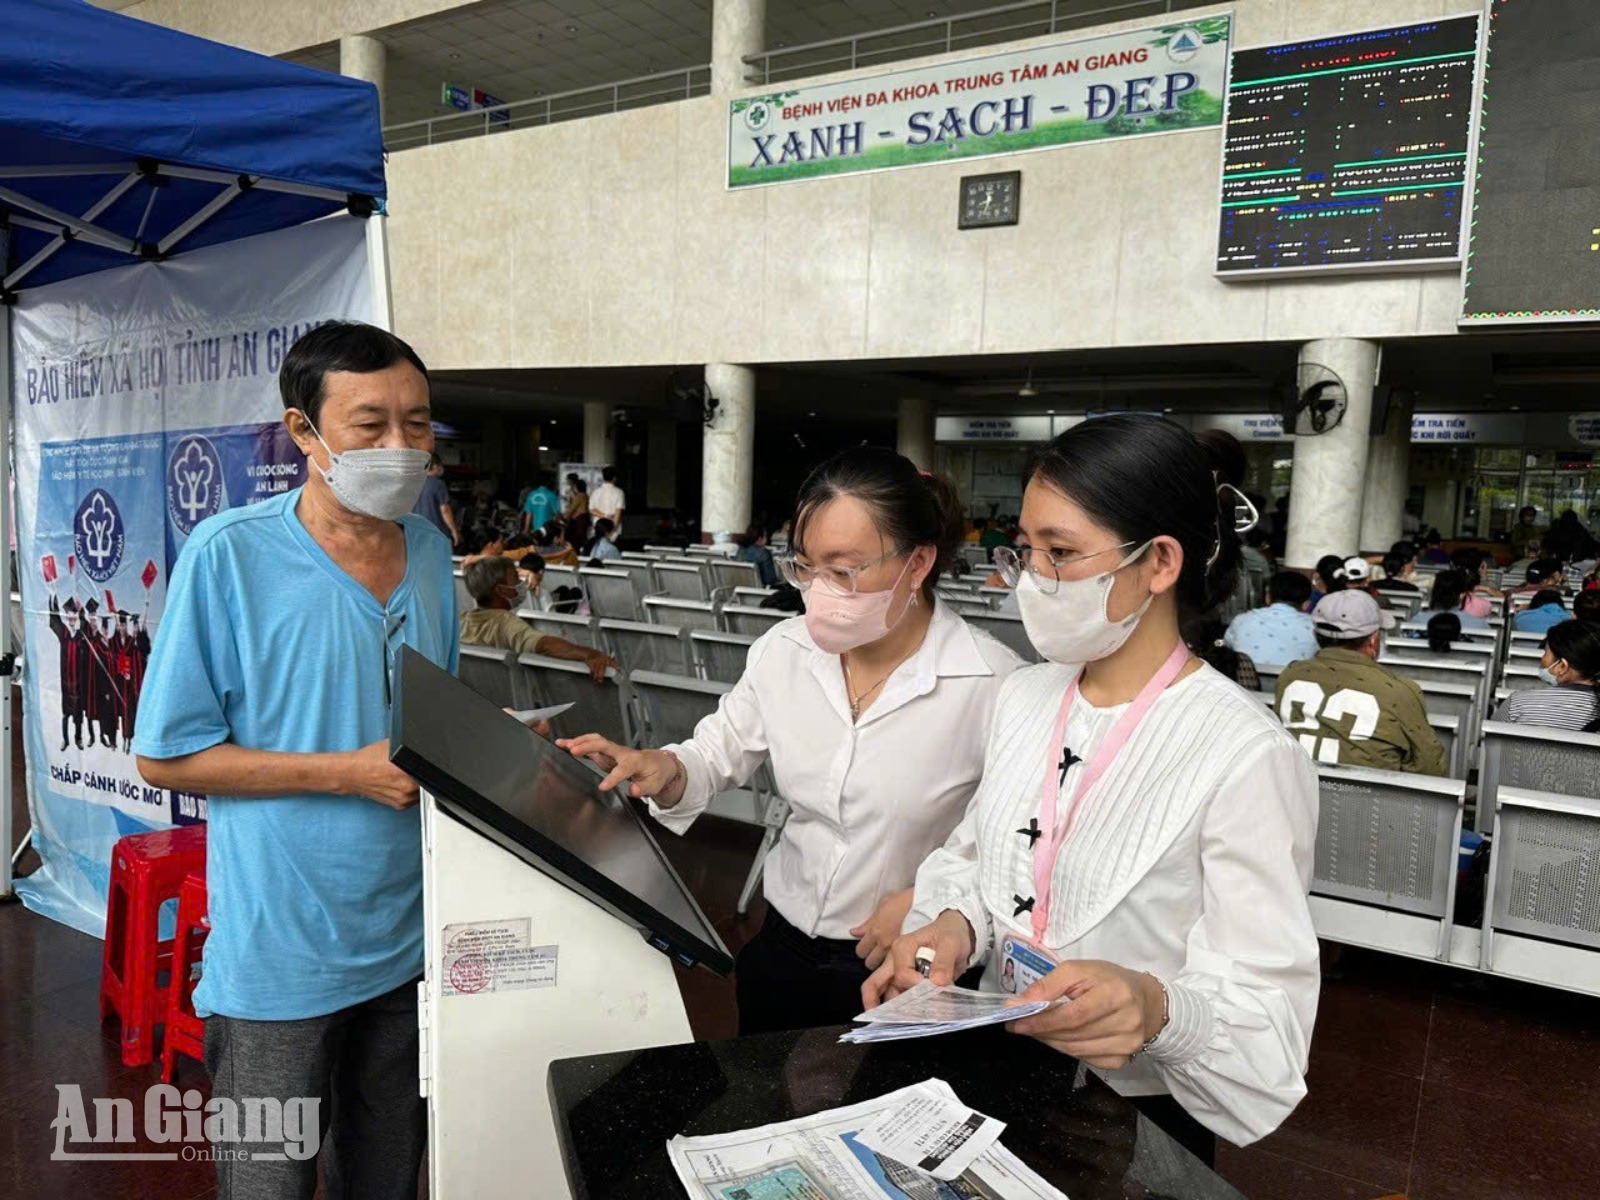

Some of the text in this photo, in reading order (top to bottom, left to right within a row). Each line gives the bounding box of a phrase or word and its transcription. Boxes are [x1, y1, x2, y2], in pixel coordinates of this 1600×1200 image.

[749, 121, 865, 169] XANH
[906, 94, 1035, 151] SẠCH
[1084, 71, 1198, 126] ĐẸP
[782, 48, 1149, 121] BỆNH VIỆN ĐA KHOA TRUNG TÂM AN GIANG
[27, 356, 59, 405] BẢO
[174, 329, 220, 385] TỈNH
[227, 331, 258, 379] AN
[1428, 419, 1443, 427] TRA
[84, 772, 117, 793] CÁNH
